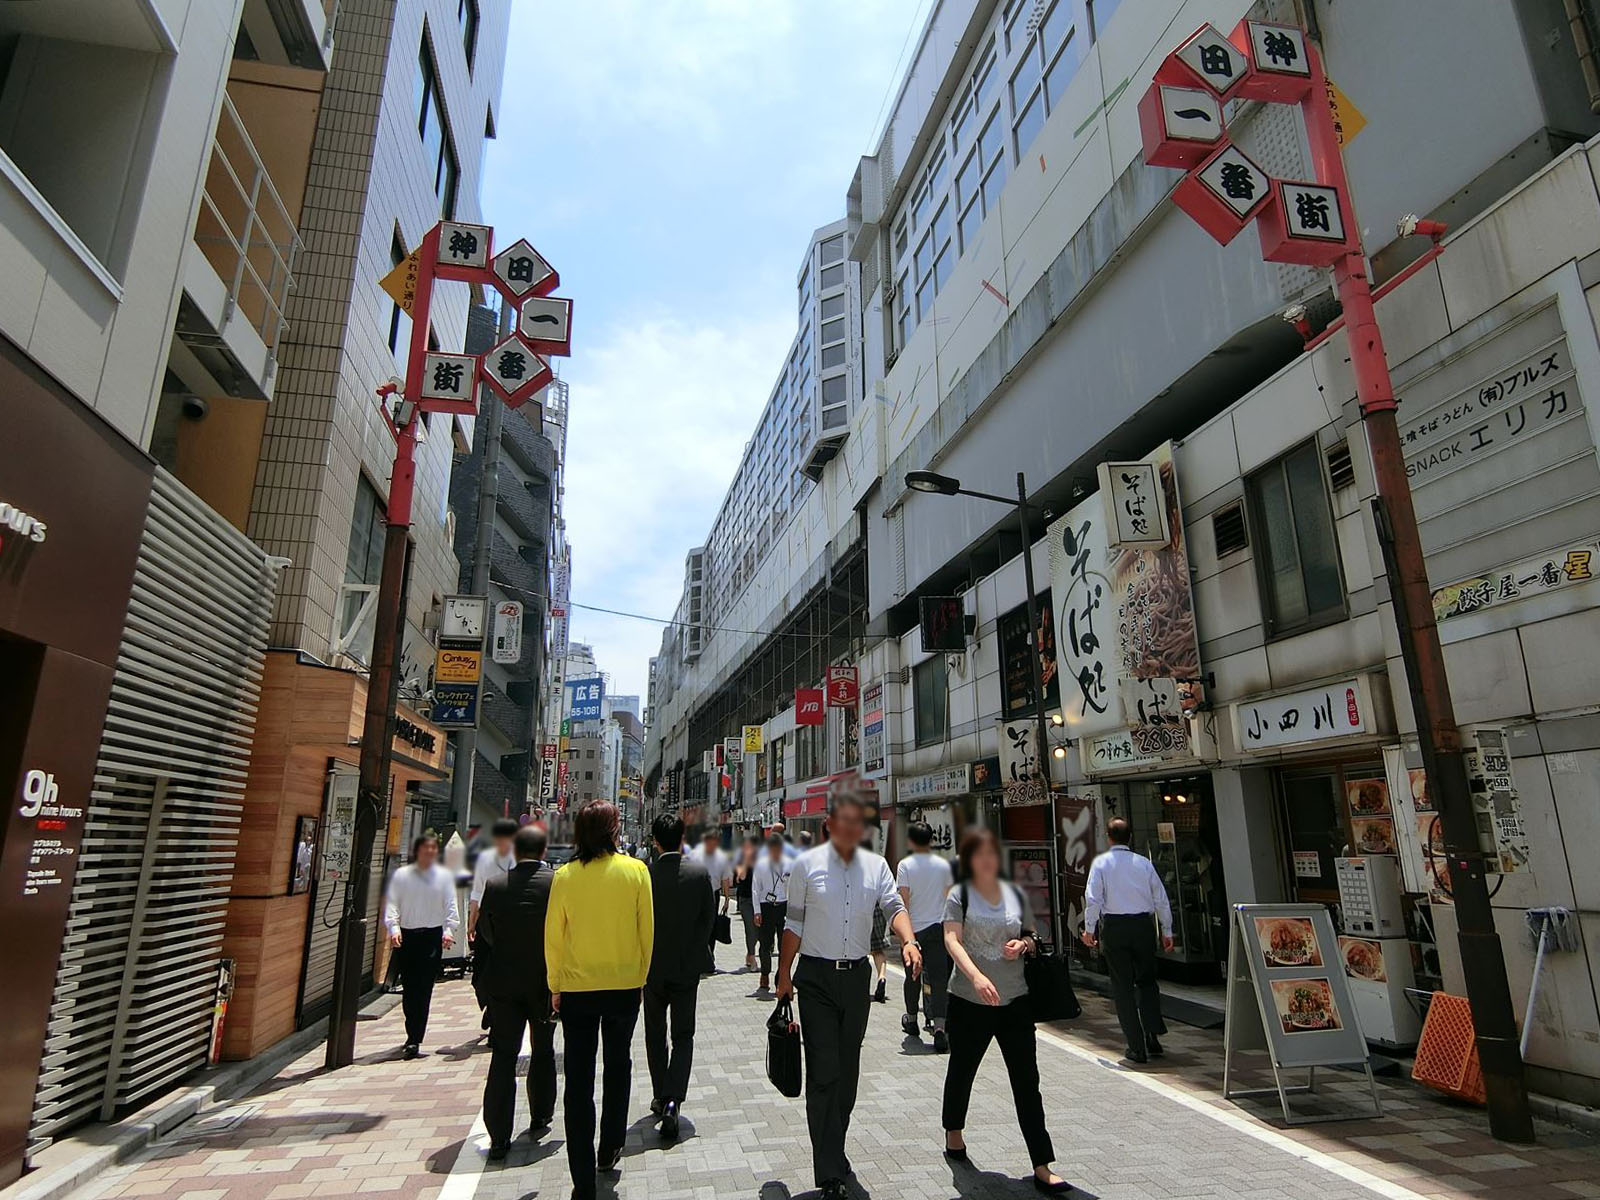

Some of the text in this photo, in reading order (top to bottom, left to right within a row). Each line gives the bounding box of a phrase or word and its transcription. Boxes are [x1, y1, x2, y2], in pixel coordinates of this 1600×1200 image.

[1405, 390, 1567, 478] SNACK エリカ
[1121, 472, 1150, 535] そば処
[1457, 549, 1593, 612] 餃子屋一番星
[1063, 519, 1108, 717] そば処
[576, 684, 600, 701] 広告
[801, 701, 819, 713] JTB
[1007, 726, 1035, 783] そば
[20, 769, 59, 818] 9h
